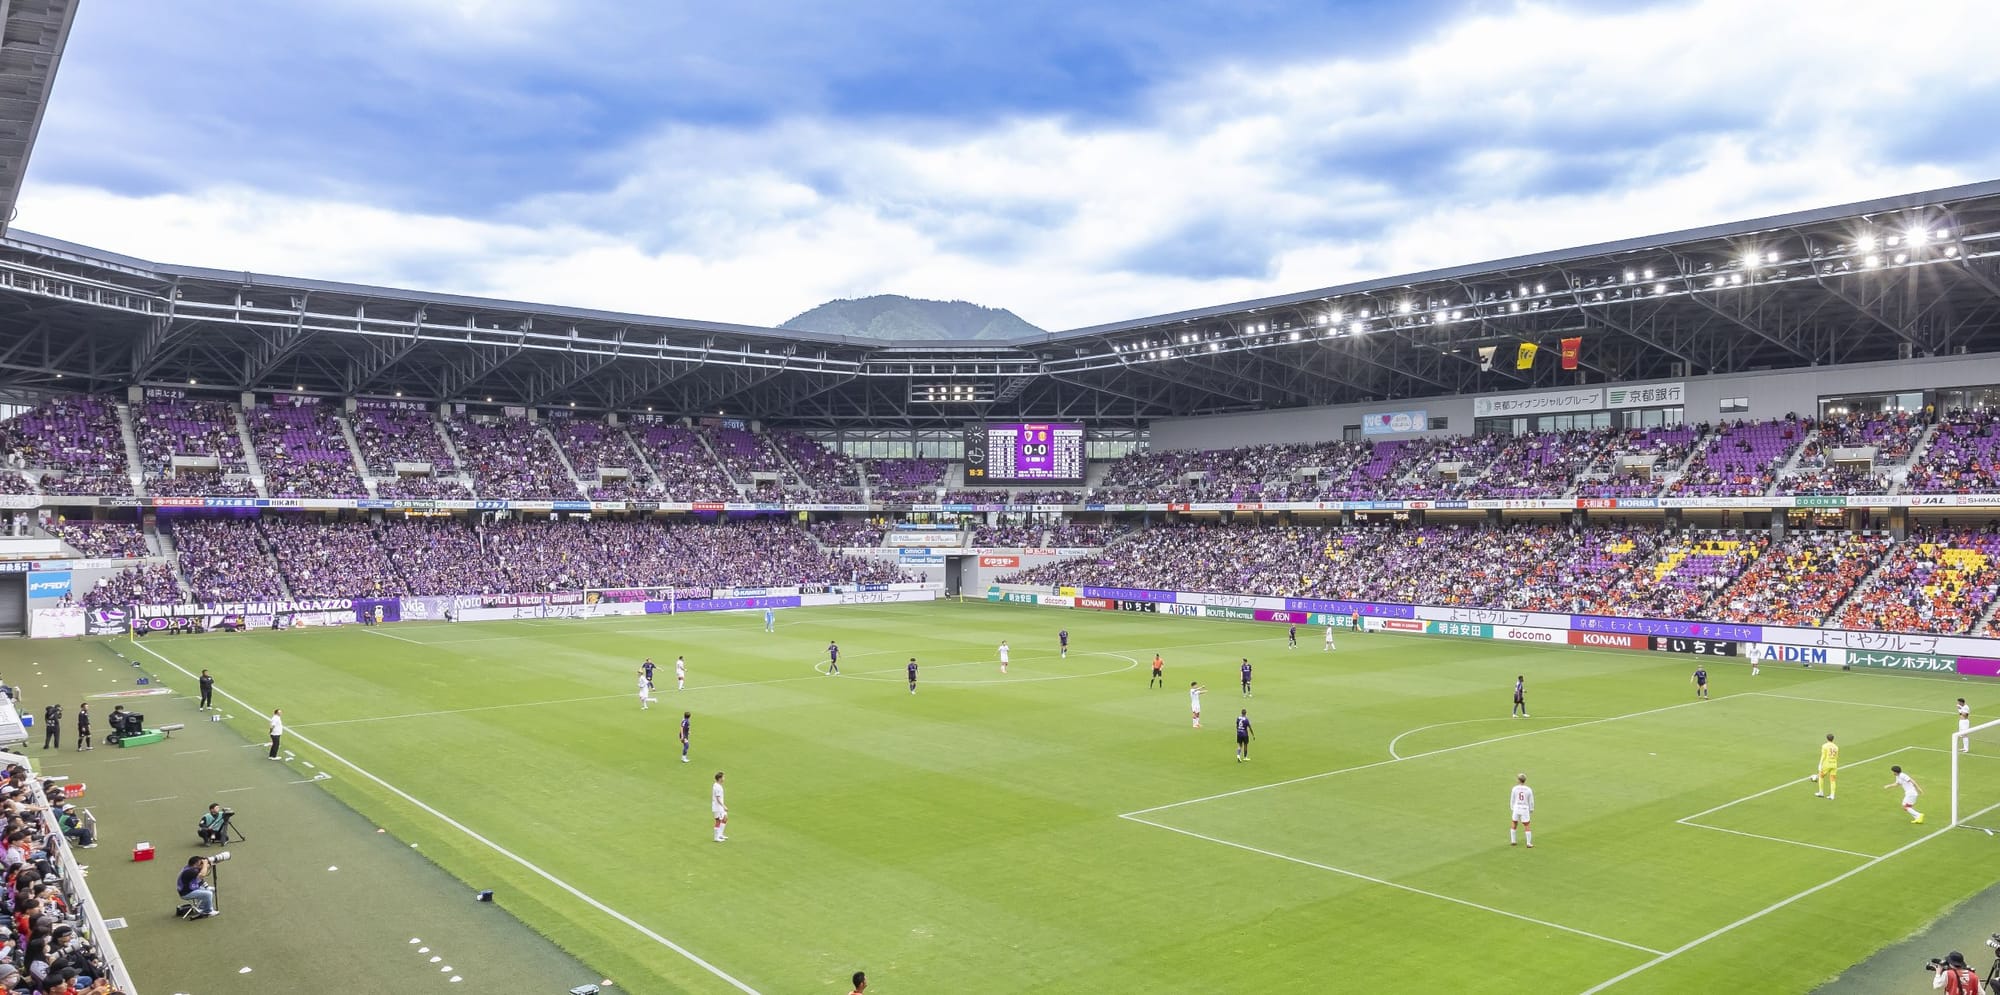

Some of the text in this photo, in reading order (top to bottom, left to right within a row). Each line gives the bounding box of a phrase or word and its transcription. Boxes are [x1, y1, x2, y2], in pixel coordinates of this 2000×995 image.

[1629, 387, 1681, 402] 京都銀行
[1494, 394, 1599, 411] 京都フィナンシャルグループ
[276, 599, 353, 612] RAGAZZO
[1081, 599, 1106, 608] KONAMI
[1125, 602, 1151, 612] いちご
[1317, 614, 1354, 626] 明治安田
[1438, 623, 1481, 636] 明治安田
[1508, 629, 1552, 641] docomo
[1583, 633, 1630, 646] KONAMI
[1815, 631, 1940, 655] よーじやグループ
[1673, 640, 1726, 655] いちご
[1518, 792, 1524, 801] 6
